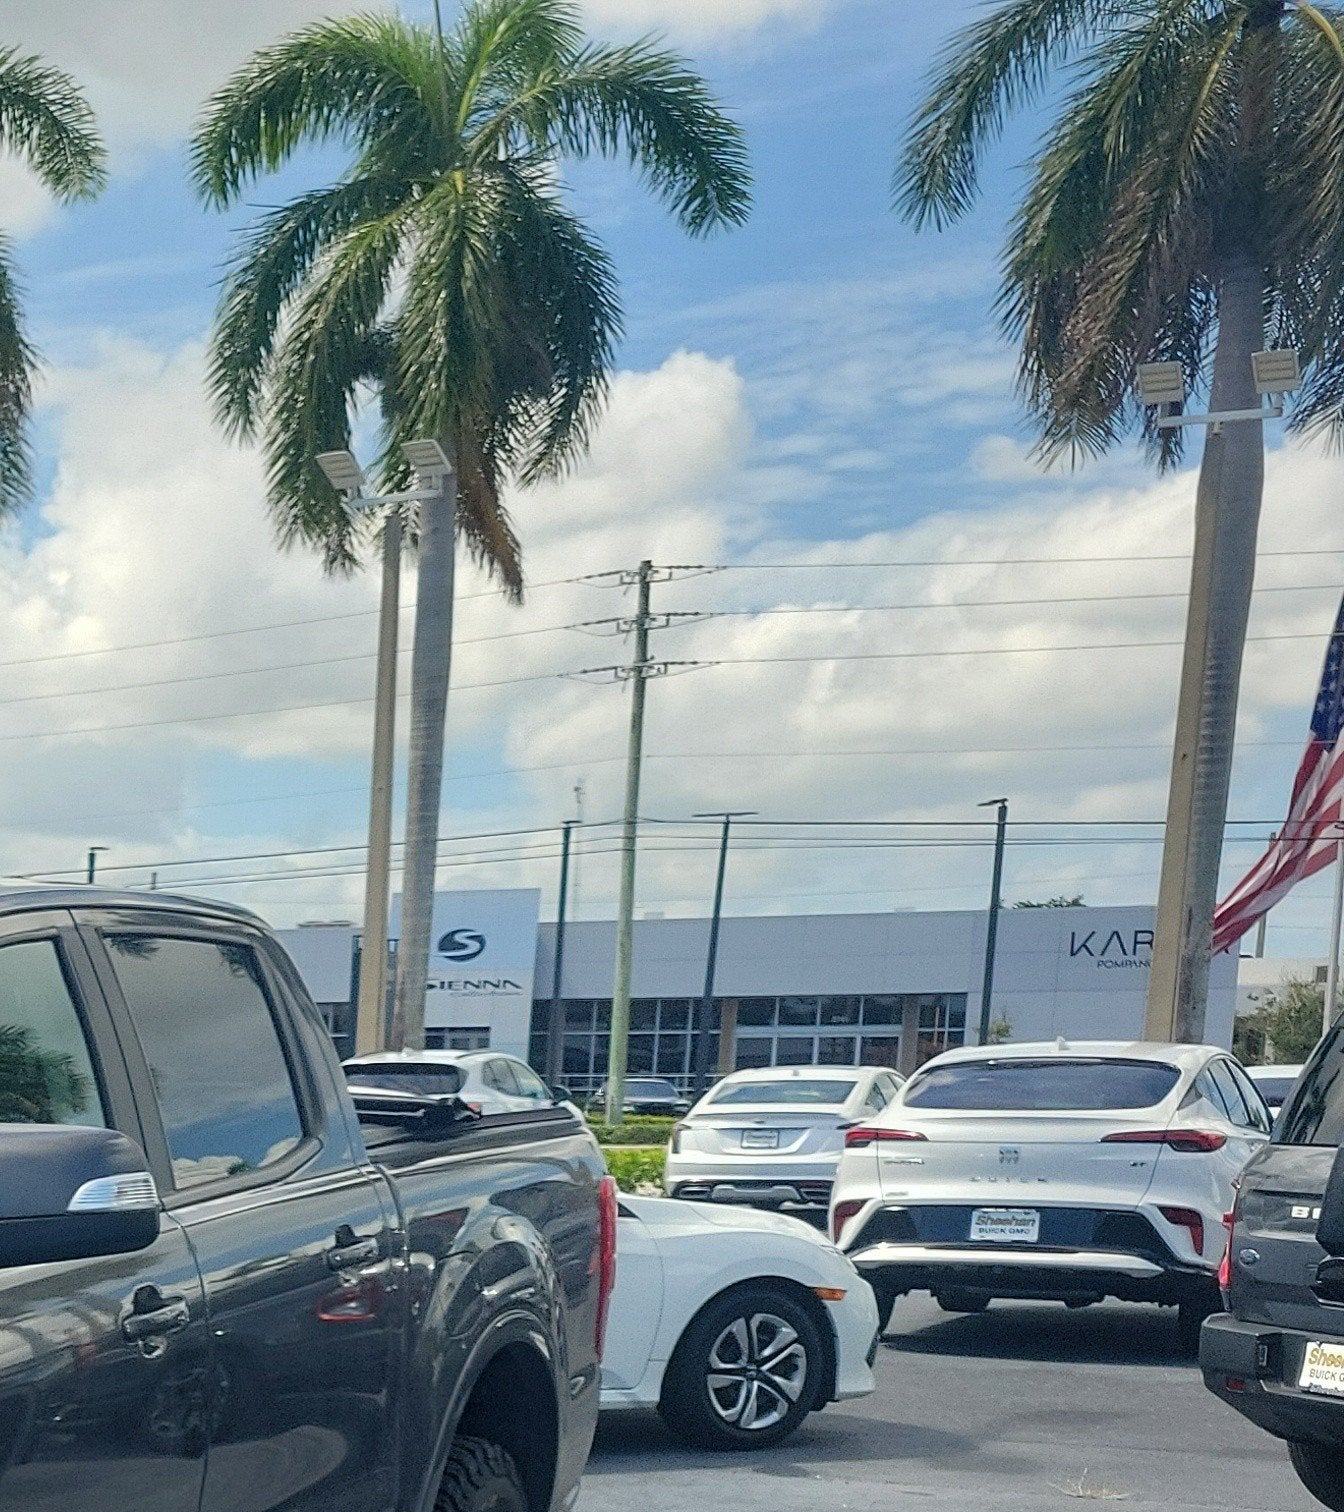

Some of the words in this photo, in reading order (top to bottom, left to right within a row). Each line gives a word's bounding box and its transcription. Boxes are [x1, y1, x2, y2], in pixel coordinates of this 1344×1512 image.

[975, 1214, 1036, 1227] Sheehan
[978, 1227, 1007, 1235] BUICK
[1308, 1347, 1344, 1368] Shee
[1309, 1368, 1338, 1381] BUICK
